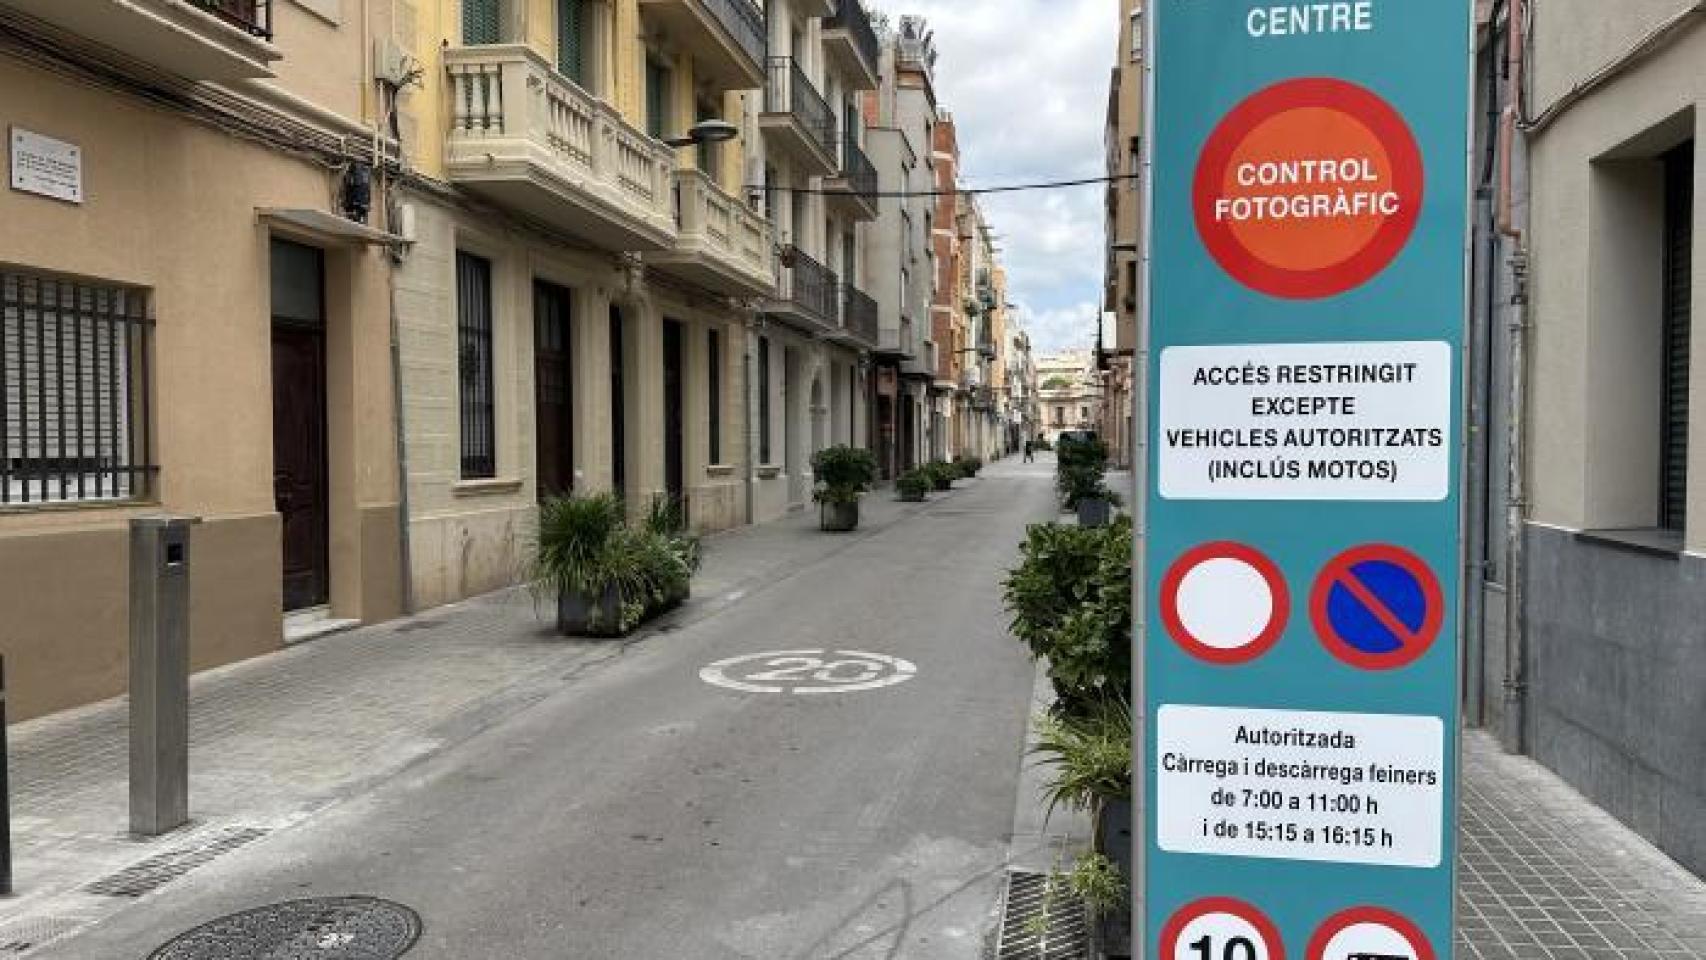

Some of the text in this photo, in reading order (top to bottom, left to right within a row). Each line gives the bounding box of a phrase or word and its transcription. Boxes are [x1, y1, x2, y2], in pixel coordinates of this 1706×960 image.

[1247, 1, 1373, 37] CENTRE
[1237, 158, 1377, 185] CONTROL
[1215, 188, 1400, 221] FOTOGRÀFIC
[1193, 361, 1417, 386] ACCÉS RESTRINGIT
[1252, 397, 1355, 415] EXCEPTE
[1167, 428, 1443, 447] VEHICLES AUTORITZATS
[1208, 456, 1398, 483] (INCLÚS MOTOS)
[745, 657, 882, 683] 20
[1235, 725, 1356, 749] Autoritzada
[1162, 752, 1437, 785] Càrrega i descàrrega feiners
[1211, 788, 1378, 814] de 7:00 a 11:00 h
[1203, 818, 1393, 848] i de 15:15 a 16:15 h
